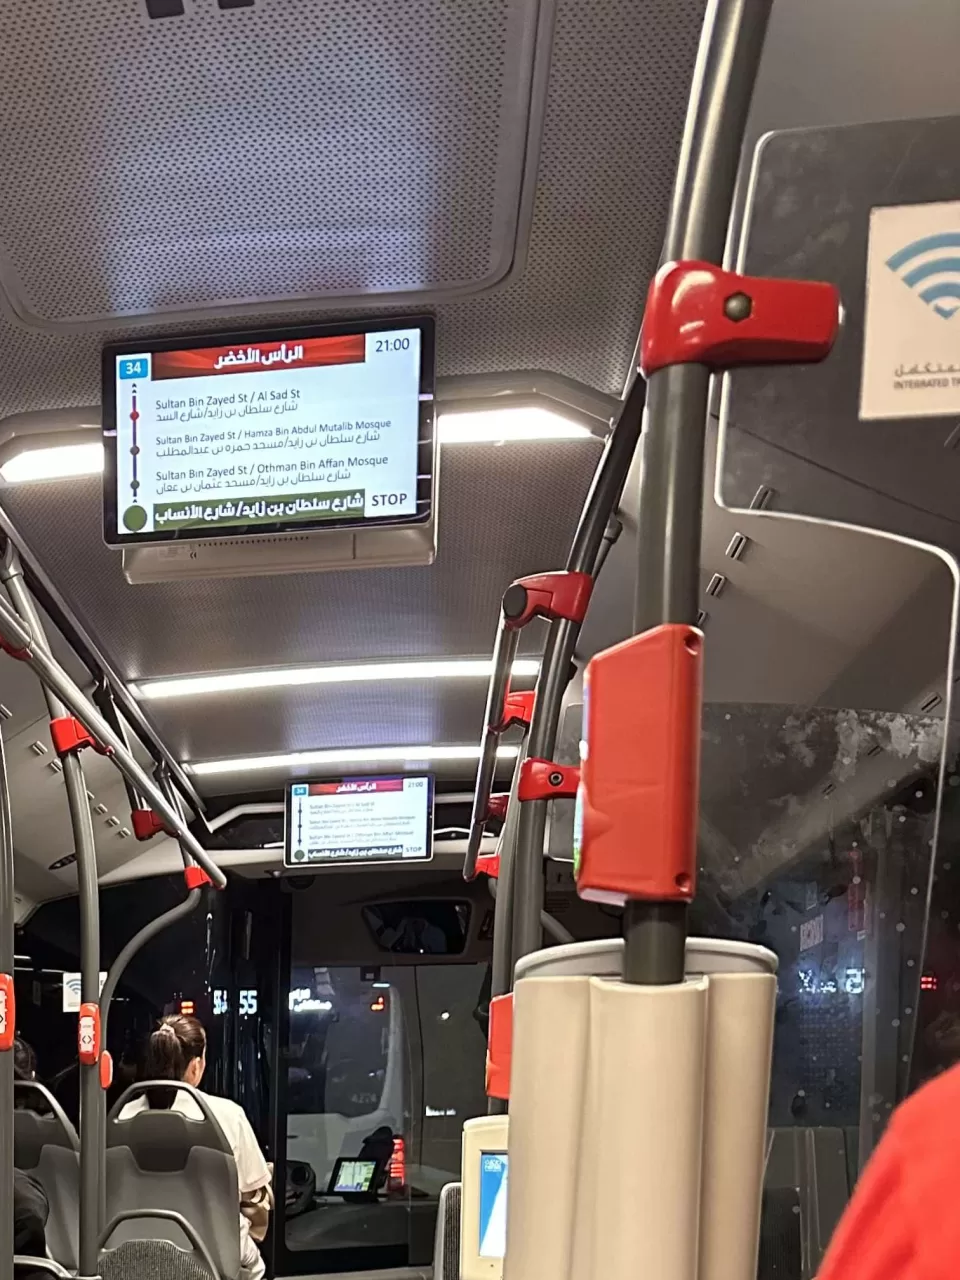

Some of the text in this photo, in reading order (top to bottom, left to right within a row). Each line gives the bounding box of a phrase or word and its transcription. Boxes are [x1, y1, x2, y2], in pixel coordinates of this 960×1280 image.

[375, 337, 410, 353] 21:00
[213, 343, 304, 370] الرأس الأخضر
[125, 362, 141, 374] 34
[155, 389, 300, 410] Sultan Bin Zayed St / Al Sad St
[238, 403, 272, 418] سلطان
[274, 400, 298, 415] شارع
[156, 411, 179, 422] السد
[156, 435, 182, 446] Sultan
[184, 434, 198, 443] Bin
[199, 432, 225, 443] Zayed
[227, 431, 236, 440] St
[244, 429, 273, 438] Hamza
[275, 427, 289, 436] Bin
[291, 424, 317, 435] Abdul
[319, 421, 353, 432] Mutalib
[355, 420, 392, 431] Mosque
[319, 433, 354, 447] سلطان
[355, 430, 380, 444] شارع
[156, 470, 186, 481] Sultan
[189, 469, 204, 479] Bin
[206, 465, 235, 479] Zayed
[237, 465, 247, 475] St
[257, 462, 297, 474] Othman
[300, 460, 316, 470] Bin
[318, 458, 345, 469] Affan
[347, 456, 389, 468] Mosque
[326, 468, 351, 482] شارع
[290, 472, 324, 485] سلطان
[285, 498, 330, 515] سلطان
[331, 492, 364, 510] شارع
[371, 493, 408, 507] STOP
[267, 501, 284, 515] بن
